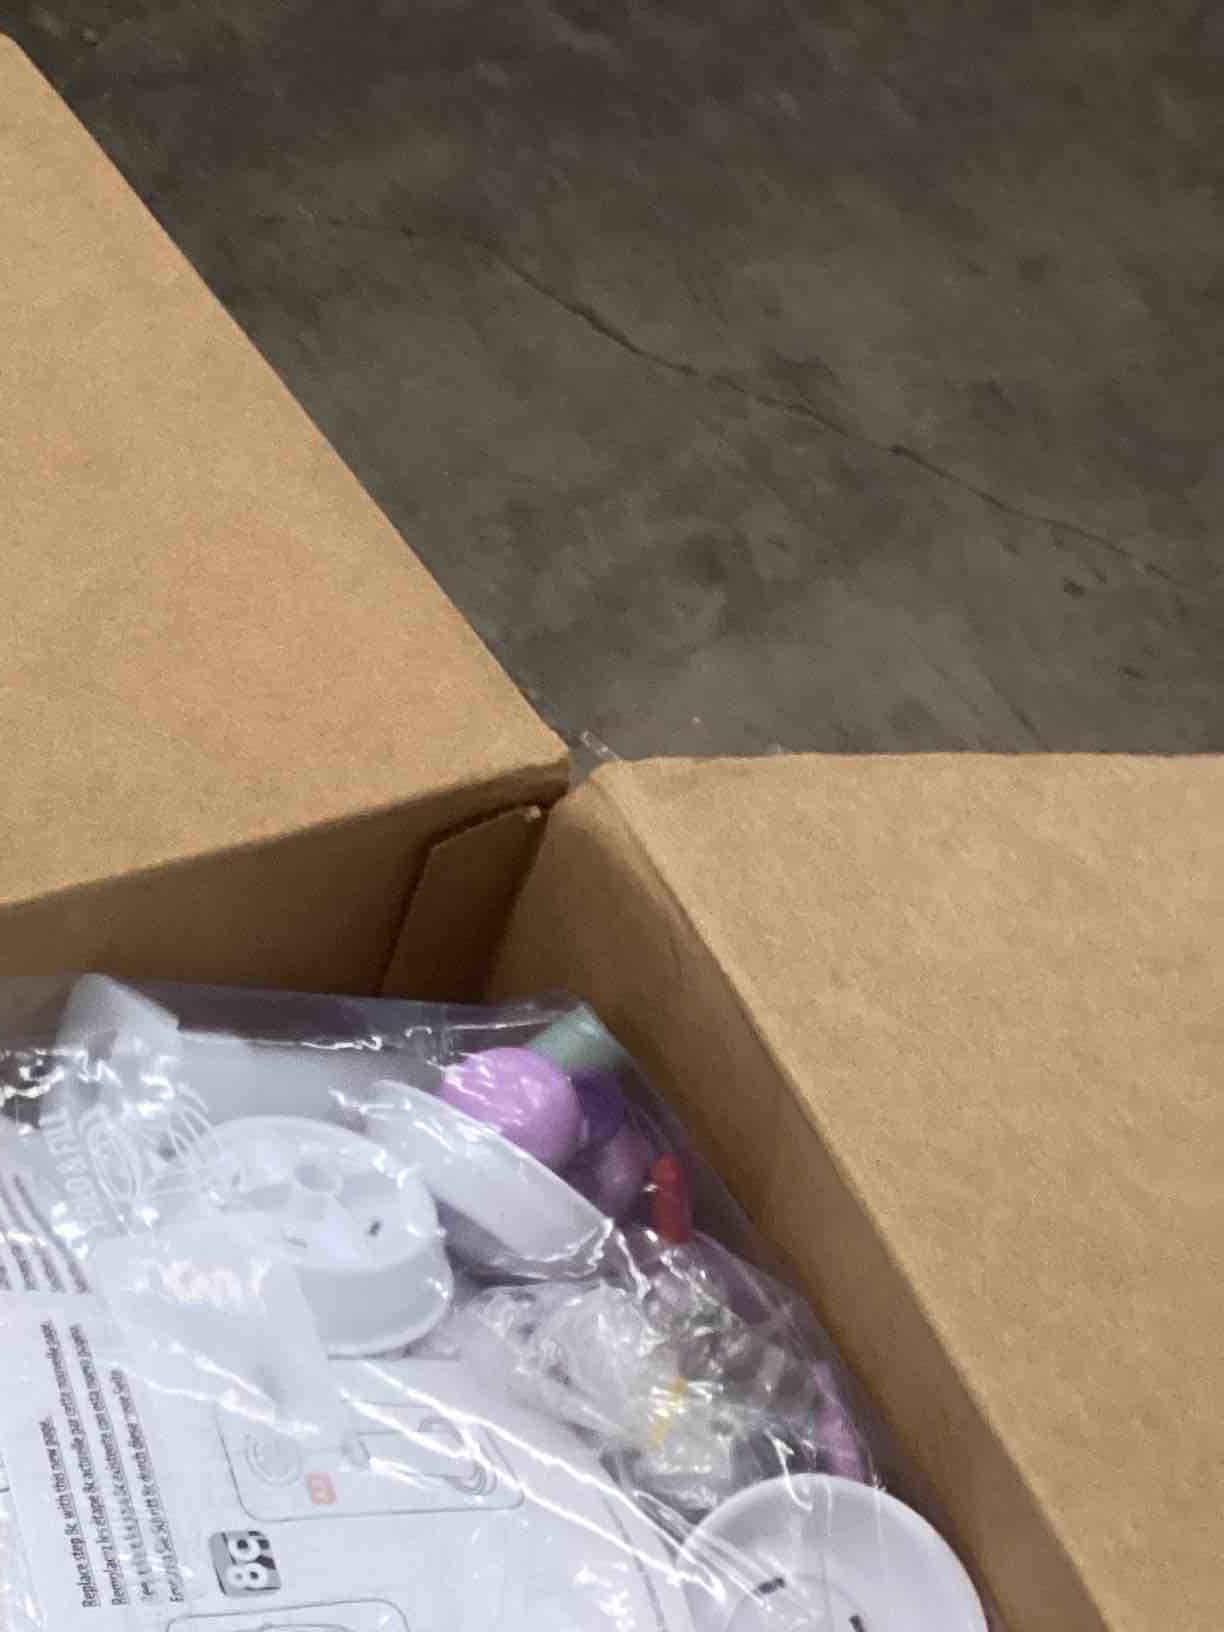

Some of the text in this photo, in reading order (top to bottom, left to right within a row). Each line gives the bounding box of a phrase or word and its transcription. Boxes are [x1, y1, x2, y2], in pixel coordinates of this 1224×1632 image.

[45, 1448, 62, 1470] new
[54, 1493, 75, 1520] with
[66, 1537, 87, 1561] step
[70, 1563, 98, 1608] Replace
